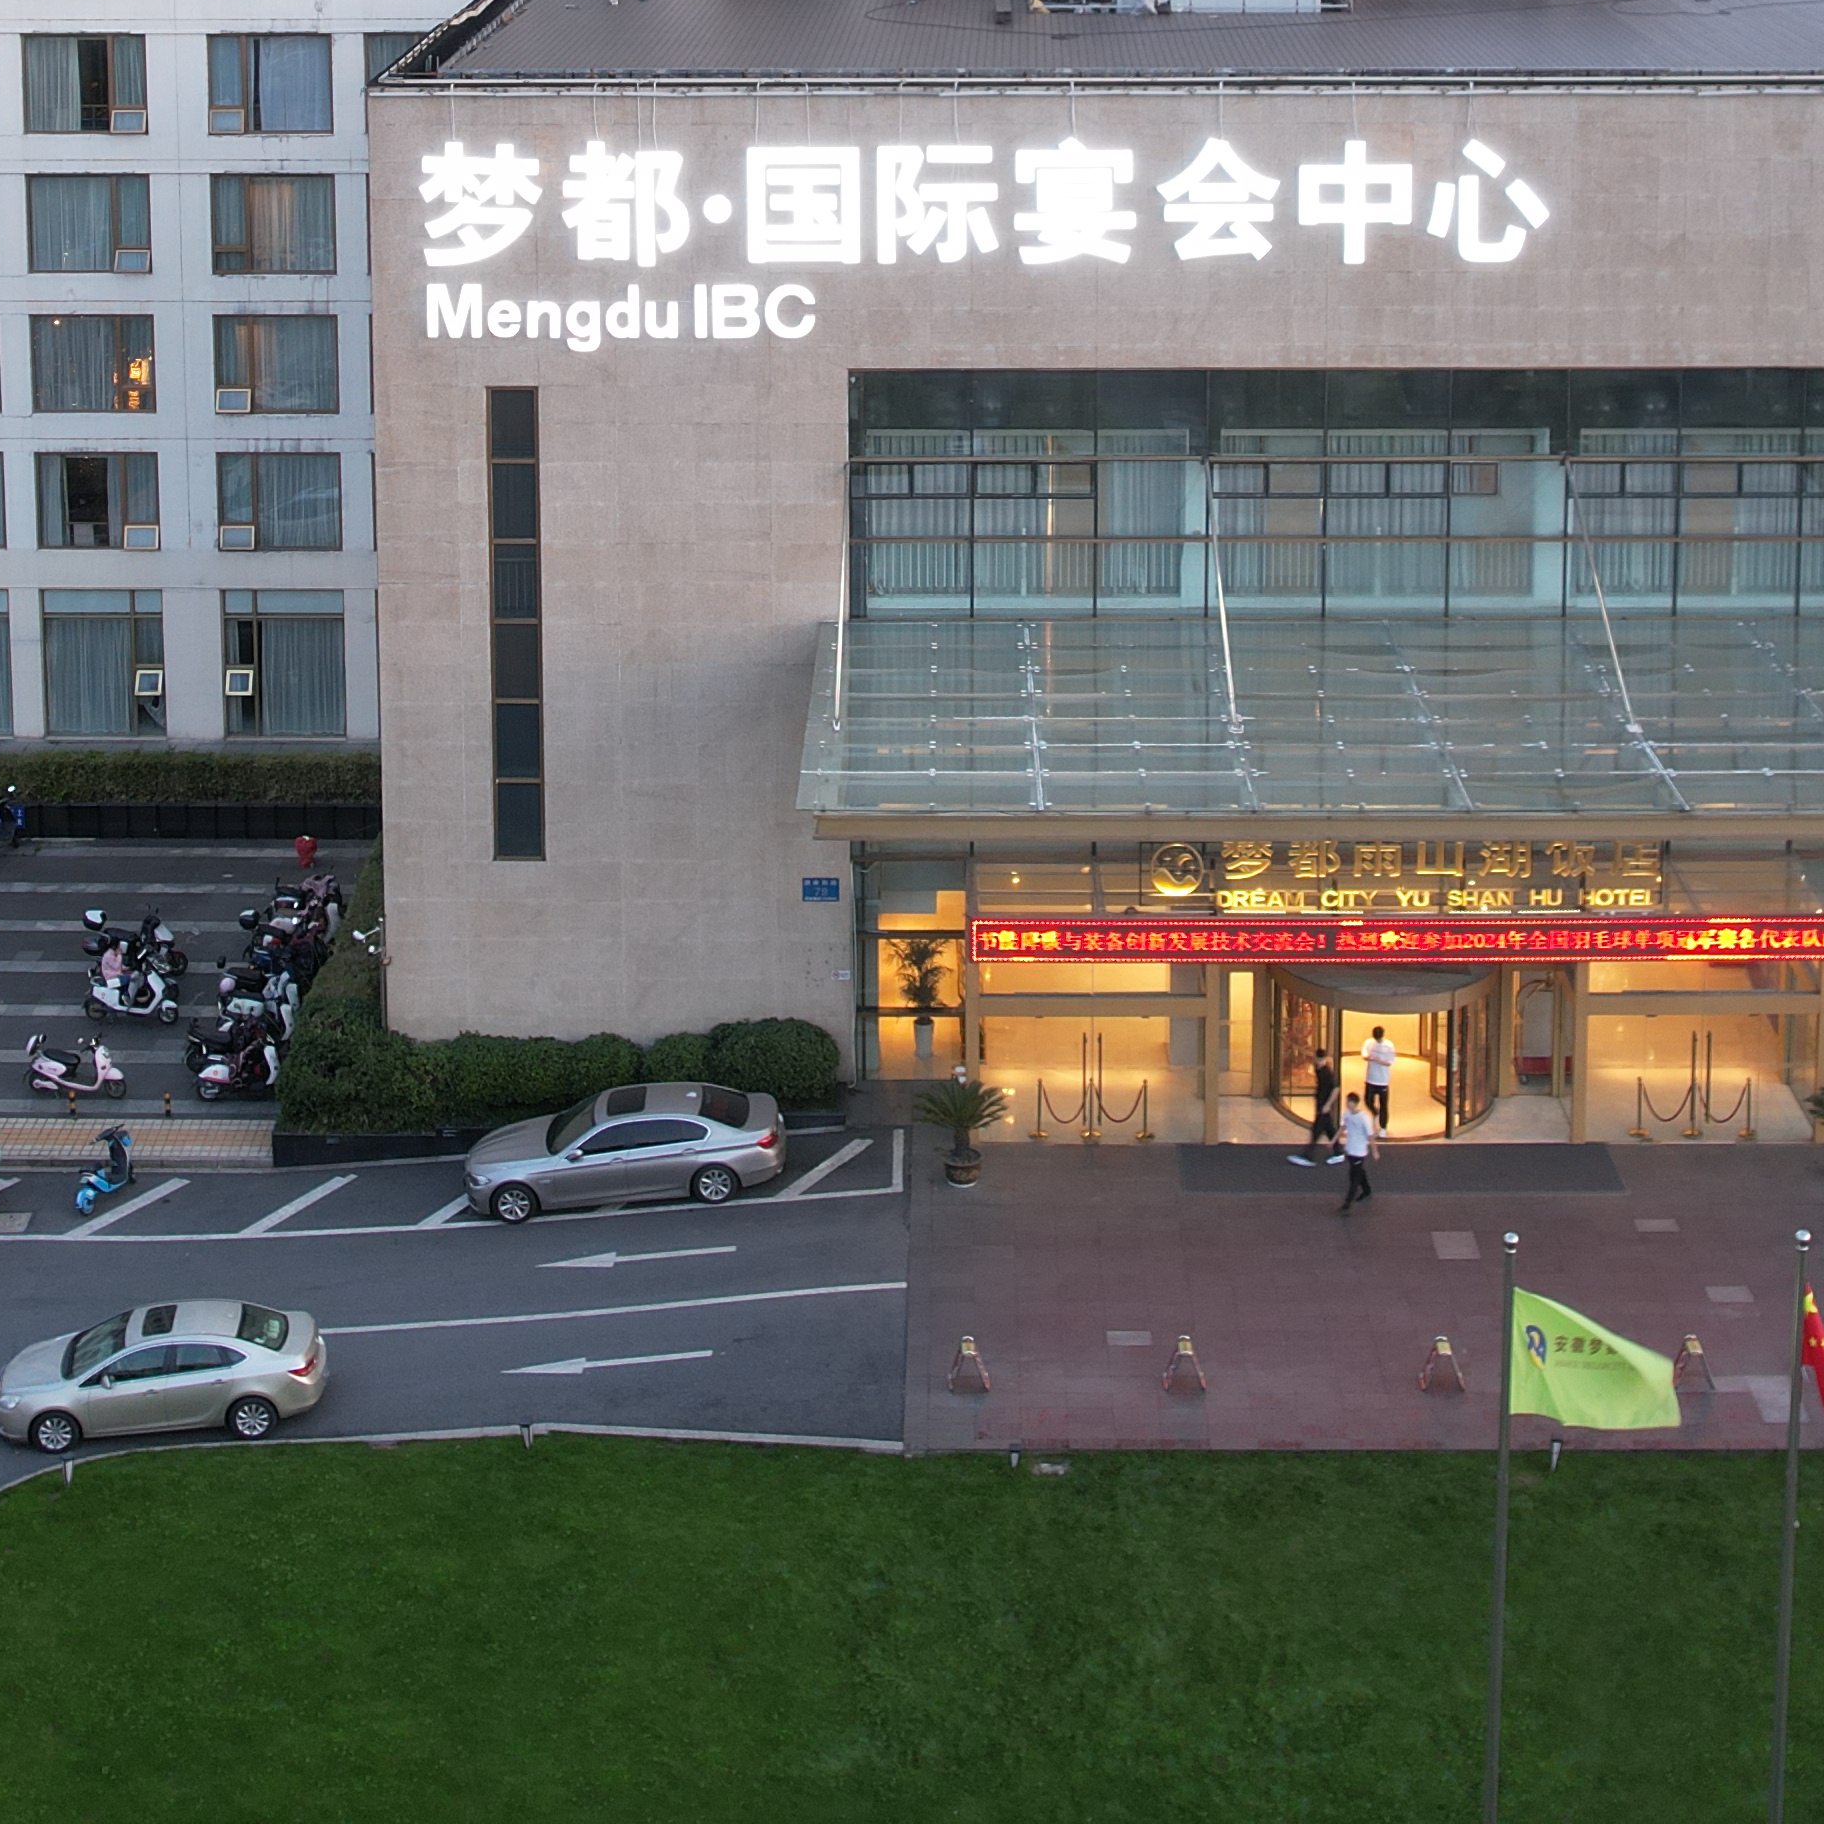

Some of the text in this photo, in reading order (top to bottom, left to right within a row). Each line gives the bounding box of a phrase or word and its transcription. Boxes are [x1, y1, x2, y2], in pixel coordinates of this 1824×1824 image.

[419, 137, 1551, 268] 梦都·国际宴会中心
[426, 283, 817, 353] Mengdu IBC
[1221, 840, 1662, 878] 梦都雨山湖饭店
[1217, 888, 1654, 907] DREAM CITY YU SHAN HU HOTEL
